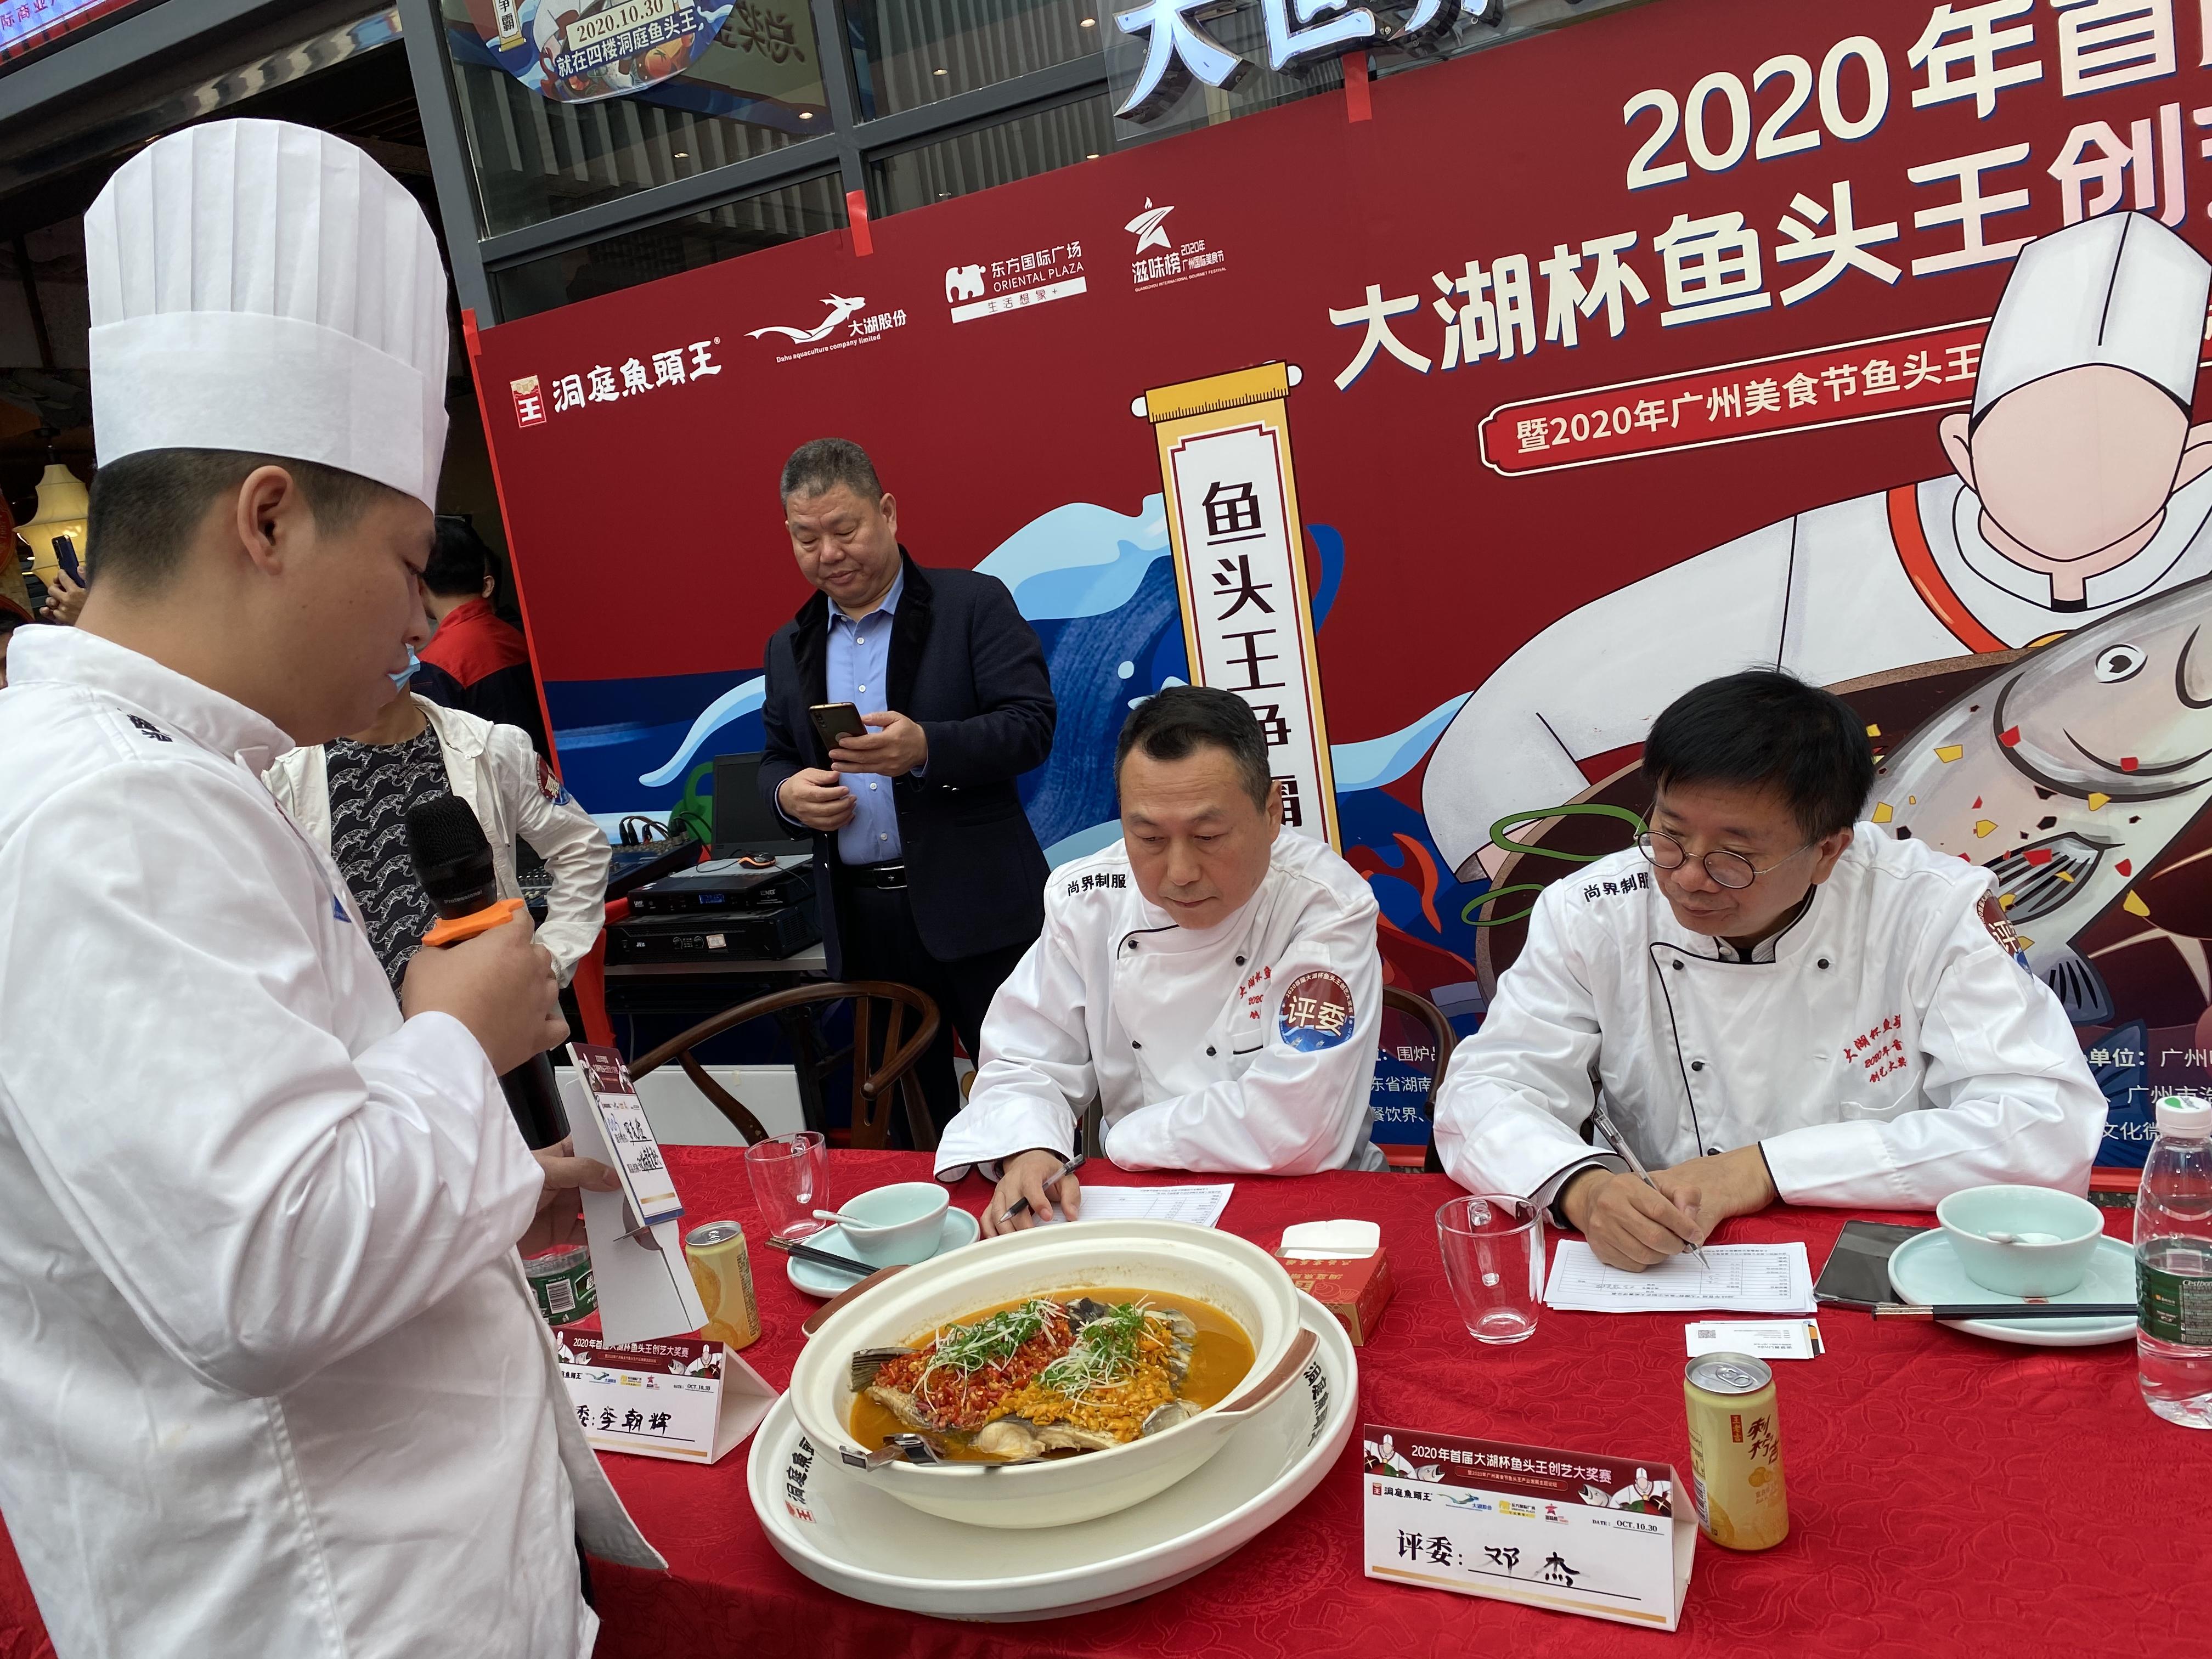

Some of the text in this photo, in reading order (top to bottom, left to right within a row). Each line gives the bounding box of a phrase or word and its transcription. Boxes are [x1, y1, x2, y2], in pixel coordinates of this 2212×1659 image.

[1, 0, 54, 30] 际商业
[577, 0, 663, 42] 2020.10.30
[556, 9, 697, 77] 就在四楼洞庭鱼头王
[1623, 0, 2212, 190] 2020年首
[991, 241, 1082, 278] 东方国际广场
[1181, 239, 1205, 256] 2020年
[1182, 250, 1224, 272] 广州国际美食节
[994, 262, 1084, 292] ORIENTAL PLAZA
[1132, 252, 1181, 284] 滋味榜
[1135, 283, 1159, 292] GUANGZHOU
[1159, 276, 1188, 286] INTERNATIONAL
[1208, 267, 1227, 275] FESTIVAL
[848, 309, 907, 337] 大湖股份
[776, 333, 881, 363] Dahu aquaculture company limited
[551, 340, 722, 413] 洞庭魚頭王
[520, 398, 544, 422] 王
[1516, 342, 1982, 455] 暨2020年广州美食节鱼头王
[1068, 873, 1126, 896] 尚界制服
[1988, 920, 2018, 953] 评
[1288, 995, 1346, 1036] 评委
[1412, 1444, 1612, 1484] 2020年首届大湖杯鱼头王创艺大奖赛
